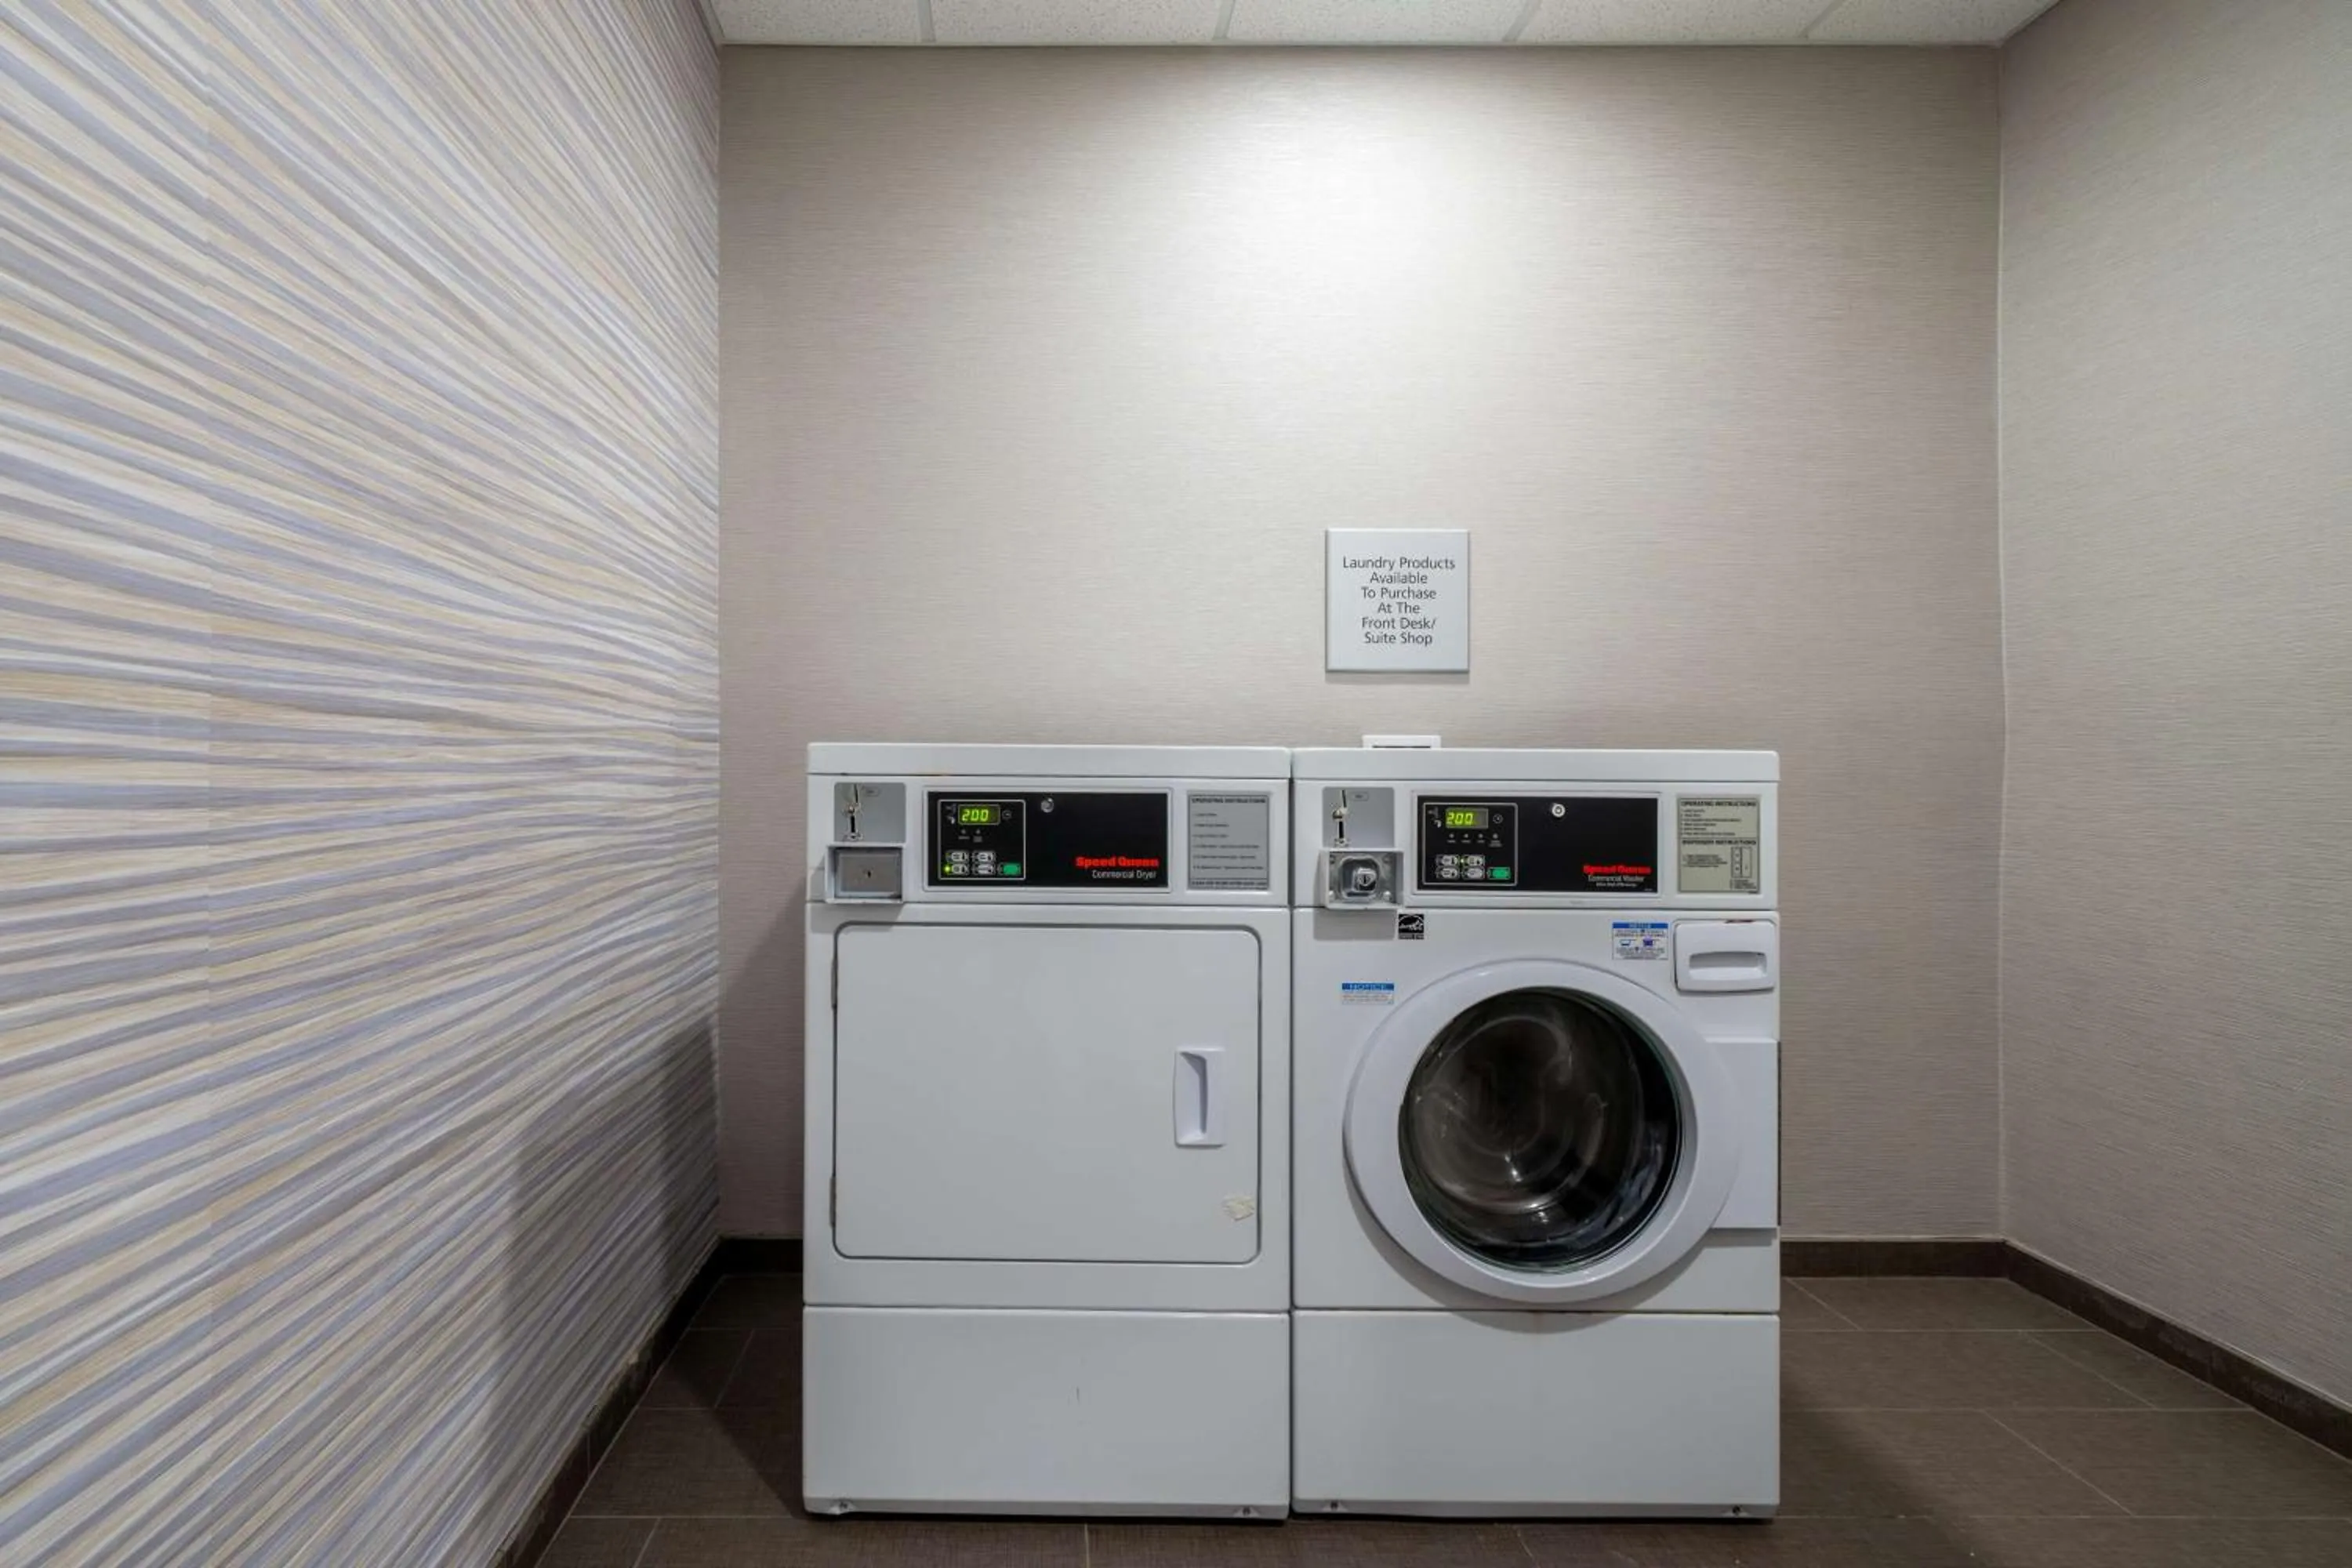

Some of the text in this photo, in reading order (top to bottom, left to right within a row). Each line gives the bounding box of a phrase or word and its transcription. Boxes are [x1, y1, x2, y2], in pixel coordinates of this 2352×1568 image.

[1343, 556, 1455, 571] Laundry Products
[1370, 572, 1428, 583] Available
[1361, 586, 1437, 599] To Purchase
[1377, 602, 1420, 613] At The
[1362, 617, 1436, 630] Front Desk/
[1364, 632, 1432, 646] Suite Shop
[961, 808, 989, 822] 200
[1446, 811, 1474, 826] 200
[1076, 856, 1159, 868] Speed Queen
[1091, 869, 1156, 880] Commercial Dryer
[1583, 865, 1652, 875] Speed Queen
